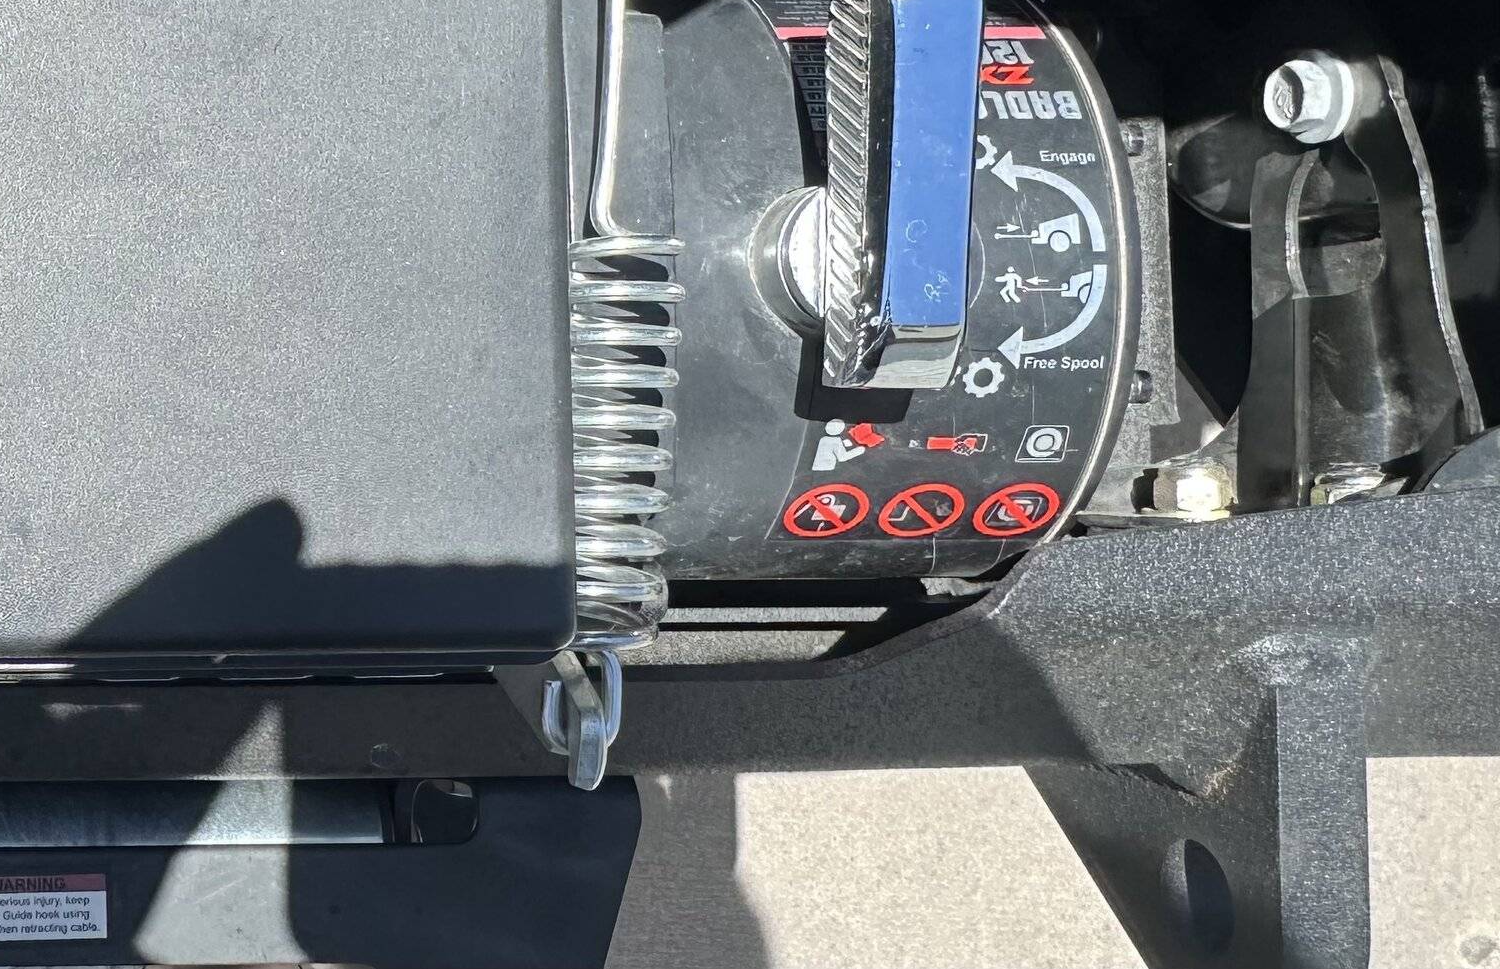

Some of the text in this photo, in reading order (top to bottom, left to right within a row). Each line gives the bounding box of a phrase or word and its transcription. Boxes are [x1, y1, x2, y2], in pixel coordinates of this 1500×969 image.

[1039, 150, 1096, 165] Engage
[1024, 355, 1104, 371] Free Spool
[65, 895, 90, 906] keep
[3, 910, 33, 920] Guide
[35, 910, 60, 919] hook
[63, 910, 90, 920] using
[21, 924, 68, 935] retracting
